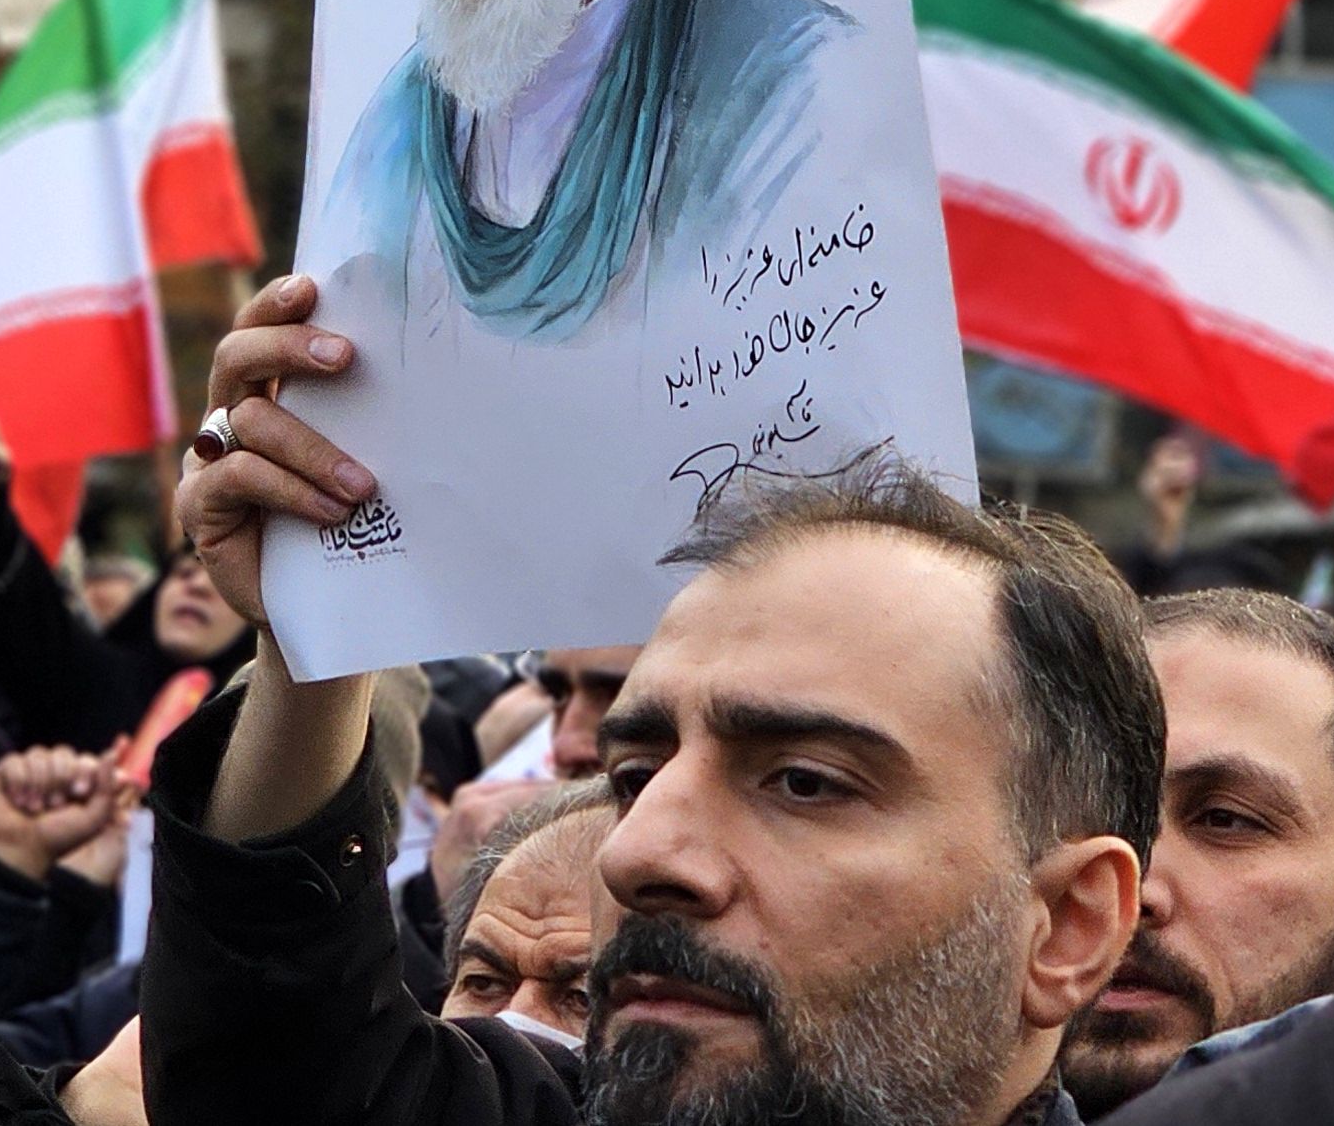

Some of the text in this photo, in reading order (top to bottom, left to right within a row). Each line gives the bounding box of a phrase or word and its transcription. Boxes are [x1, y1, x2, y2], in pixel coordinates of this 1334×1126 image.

[701, 245, 718, 295] را
[722, 244, 774, 312] عزیز
[768, 309, 816, 355] جان
[819, 280, 888, 351] عزیز
[664, 345, 727, 409] بدانید
